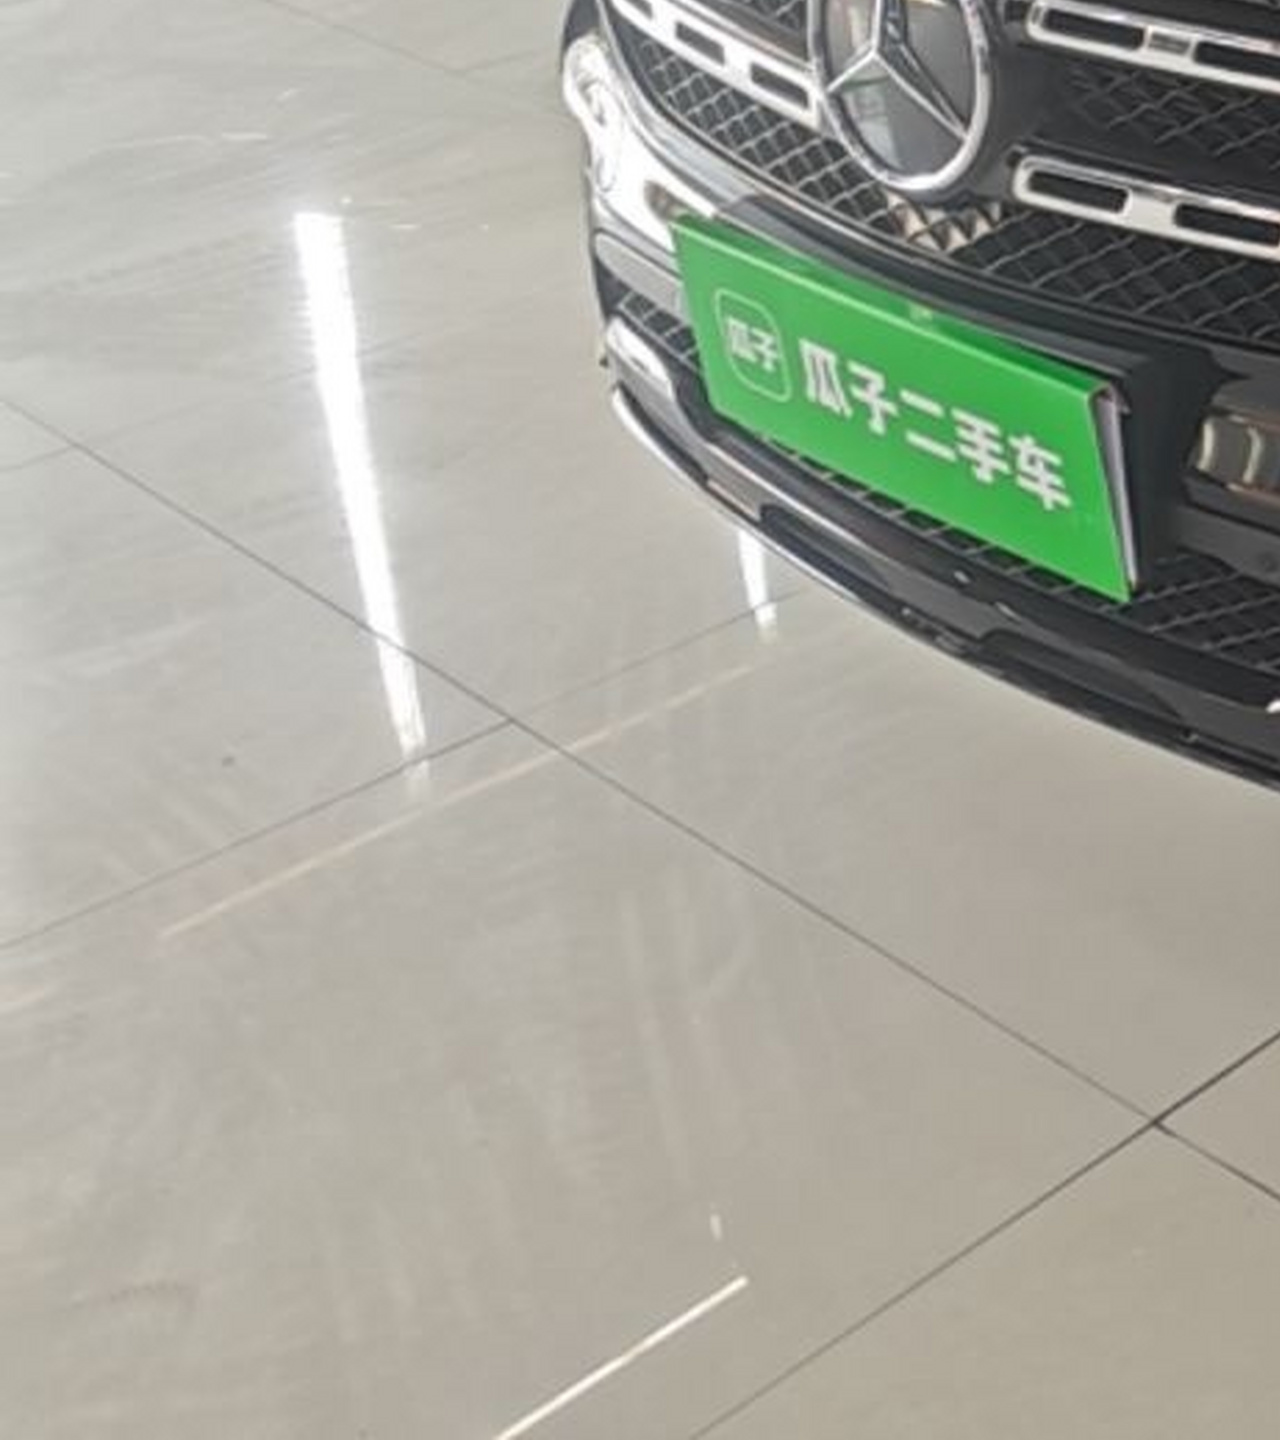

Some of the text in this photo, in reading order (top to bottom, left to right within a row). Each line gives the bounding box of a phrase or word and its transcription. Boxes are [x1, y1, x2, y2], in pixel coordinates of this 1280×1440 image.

[799, 337, 1072, 511] 瓜子二手车
